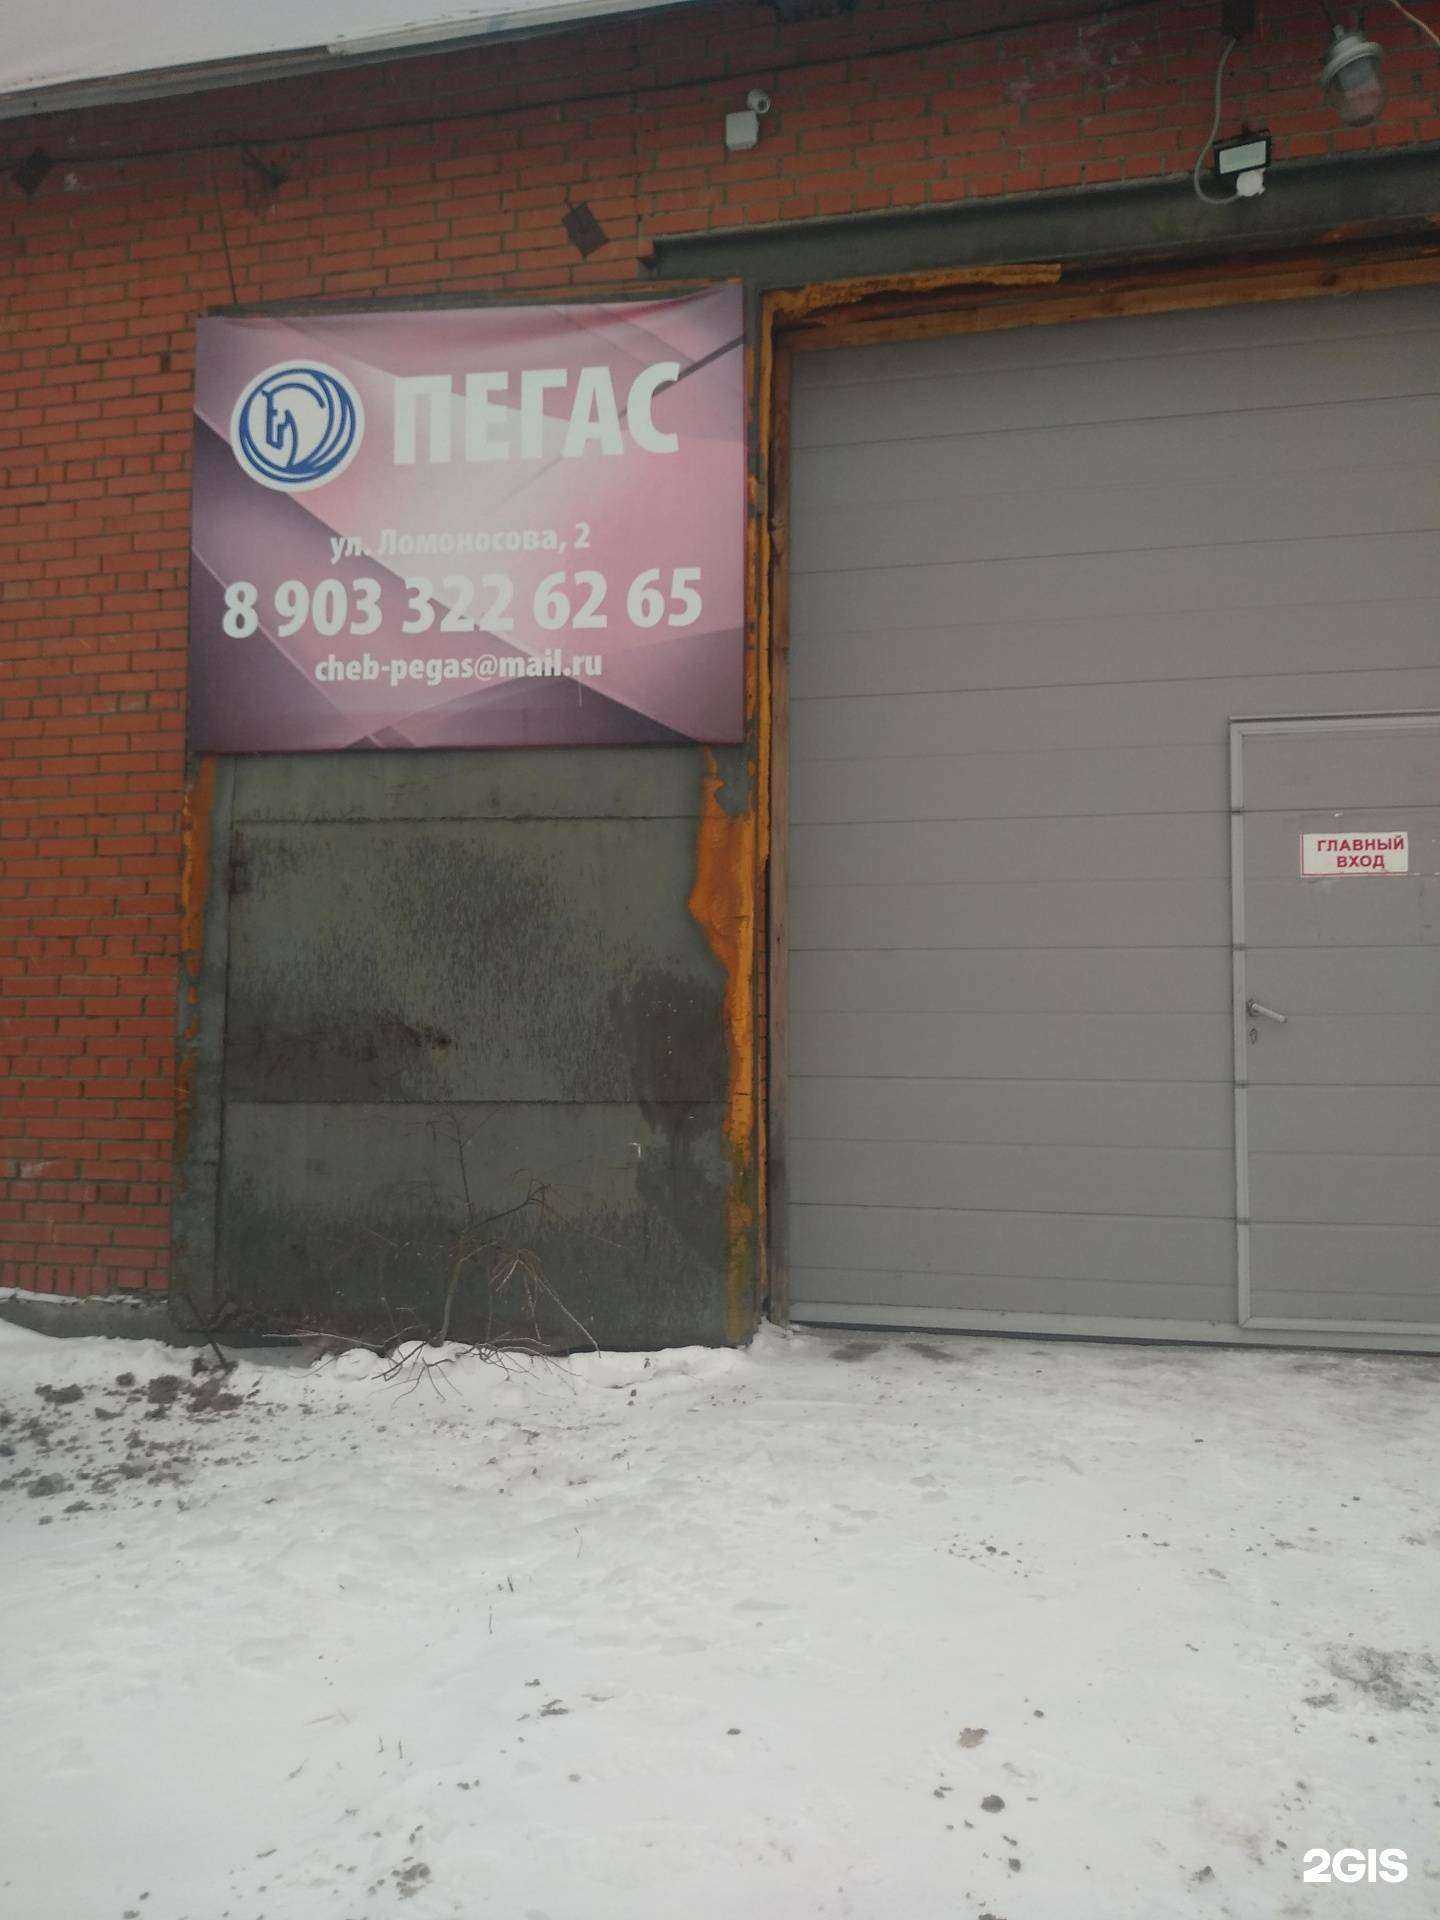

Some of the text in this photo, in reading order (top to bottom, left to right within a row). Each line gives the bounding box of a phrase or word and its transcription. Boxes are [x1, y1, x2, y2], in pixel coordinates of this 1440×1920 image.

[393, 361, 681, 466] ПЕГАС
[330, 523, 591, 564] ул. Ломоносова, 2
[222, 566, 703, 639] 8 903 322 62 65
[314, 648, 603, 686] cheb-pegas@mail.ru
[1317, 835, 1404, 852] ГЛАВНЫЙ
[1337, 855, 1385, 868] ВХОД
